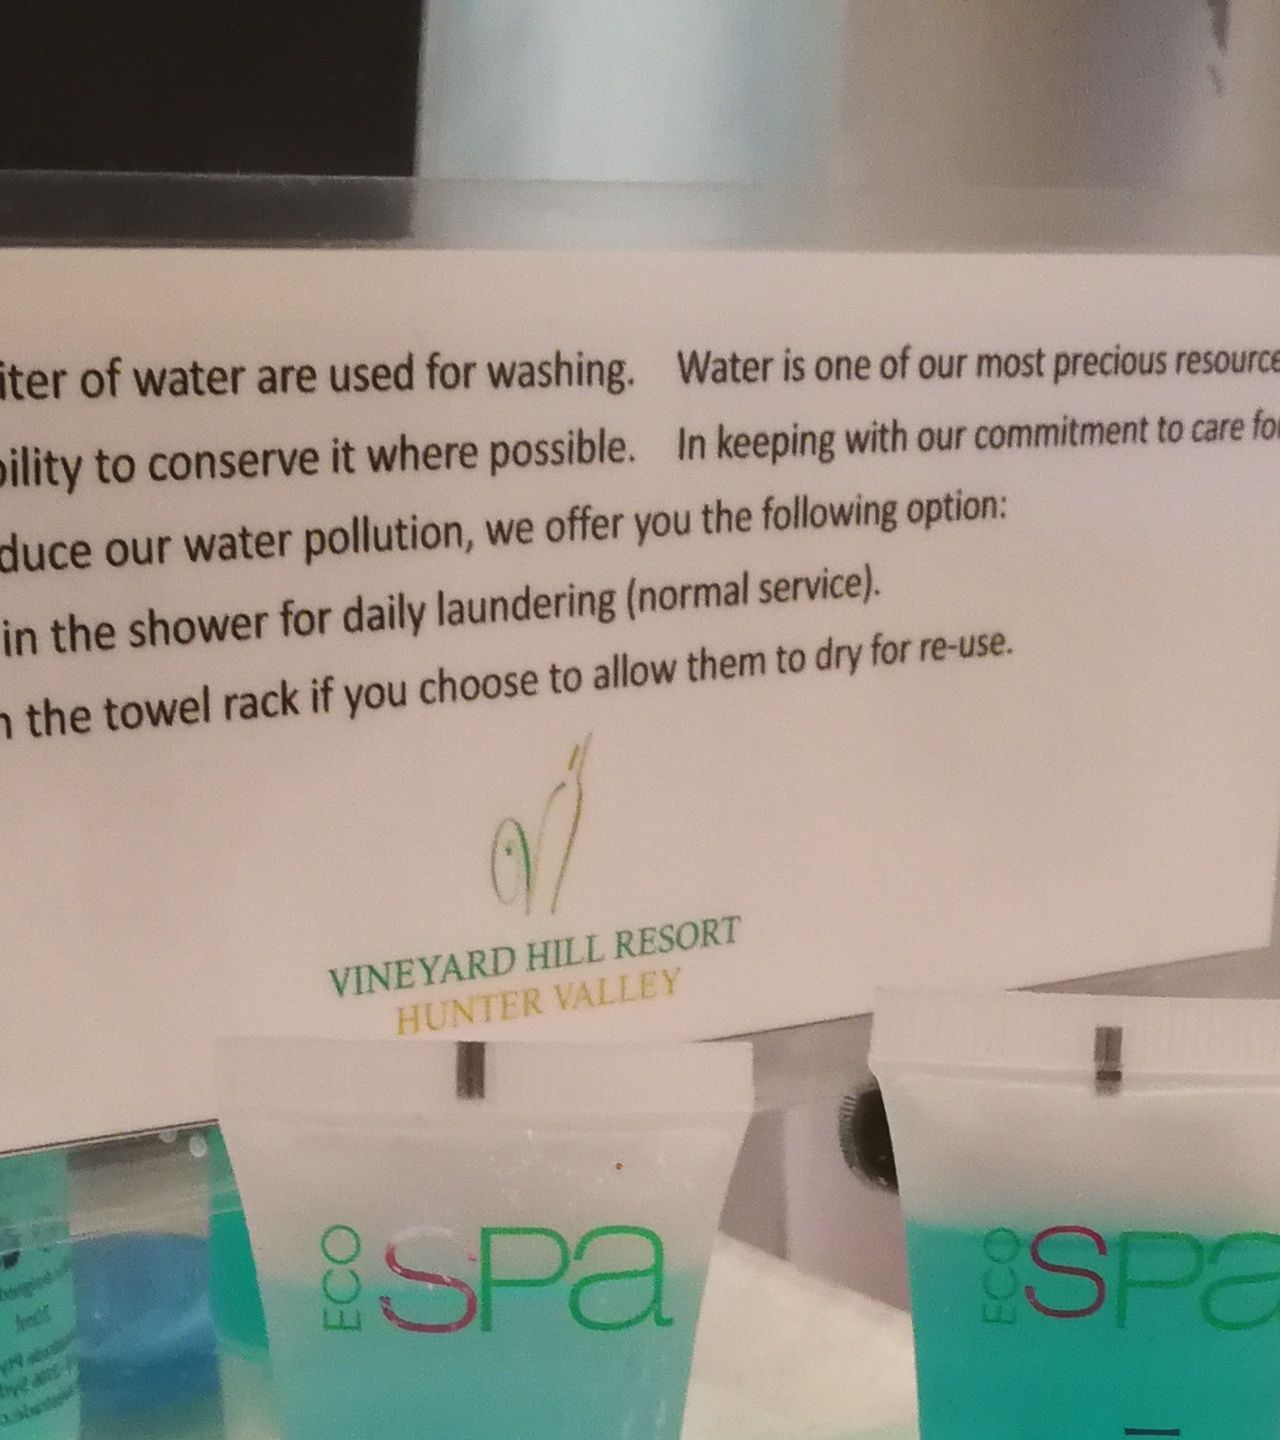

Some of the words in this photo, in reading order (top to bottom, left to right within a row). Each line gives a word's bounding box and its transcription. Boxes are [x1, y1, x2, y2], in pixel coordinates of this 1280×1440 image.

[80, 356, 122, 399] of
[133, 361, 246, 397] water
[257, 364, 317, 394] are
[330, 352, 414, 393] used
[426, 351, 477, 390] for
[487, 350, 634, 395] washing.
[677, 350, 774, 384] Water
[784, 348, 805, 382] is
[815, 355, 871, 382] one
[880, 344, 911, 380] of
[918, 354, 968, 380] our
[977, 348, 1046, 378] most
[1054, 344, 1167, 385] precious
[95, 449, 135, 484] to
[148, 447, 319, 482] conserve
[332, 437, 355, 474] it
[367, 433, 478, 473] where
[491, 427, 635, 477] possible.
[678, 427, 706, 461] In
[717, 423, 835, 465] keeping
[845, 419, 907, 454] with
[917, 426, 967, 452] our
[974, 415, 1149, 450] commitment
[1157, 416, 1184, 443] to
[1191, 418, 1245, 442] care
[105, 536, 172, 567] our
[184, 526, 292, 562] water
[305, 514, 473, 566] pollution,
[486, 518, 534, 546] we
[545, 504, 624, 543] offer
[634, 511, 690, 546] you
[701, 499, 752, 535] the
[762, 494, 898, 533] following
[907, 489, 1006, 530] option:
[3, 620, 37, 657] in
[50, 613, 116, 654] the
[129, 608, 269, 648] shower
[279, 599, 332, 637] for
[343, 592, 426, 637] daily
[438, 583, 616, 626] laundering
[627, 570, 749, 620] (normal
[759, 563, 880, 604] service).
[26, 697, 91, 738] the
[103, 685, 210, 732] towel
[225, 679, 300, 721] rack
[312, 675, 334, 714] if
[344, 681, 406, 720] you
[419, 667, 538, 705] choose
[549, 664, 582, 694] to
[593, 652, 677, 690] allow
[687, 647, 766, 683] them
[776, 646, 806, 674] to
[815, 637, 862, 676] dry
[871, 632, 912, 666] for
[920, 632, 1012, 661] re-use.
[328, 946, 517, 998] VINEYARD
[527, 934, 604, 971] HILL
[615, 915, 741, 959] RESORT
[396, 987, 543, 1037] HUNTER
[550, 969, 680, 1012] VALLEY
[320, 1224, 362, 1332] ECO
[982, 1226, 1020, 1326] ECO
